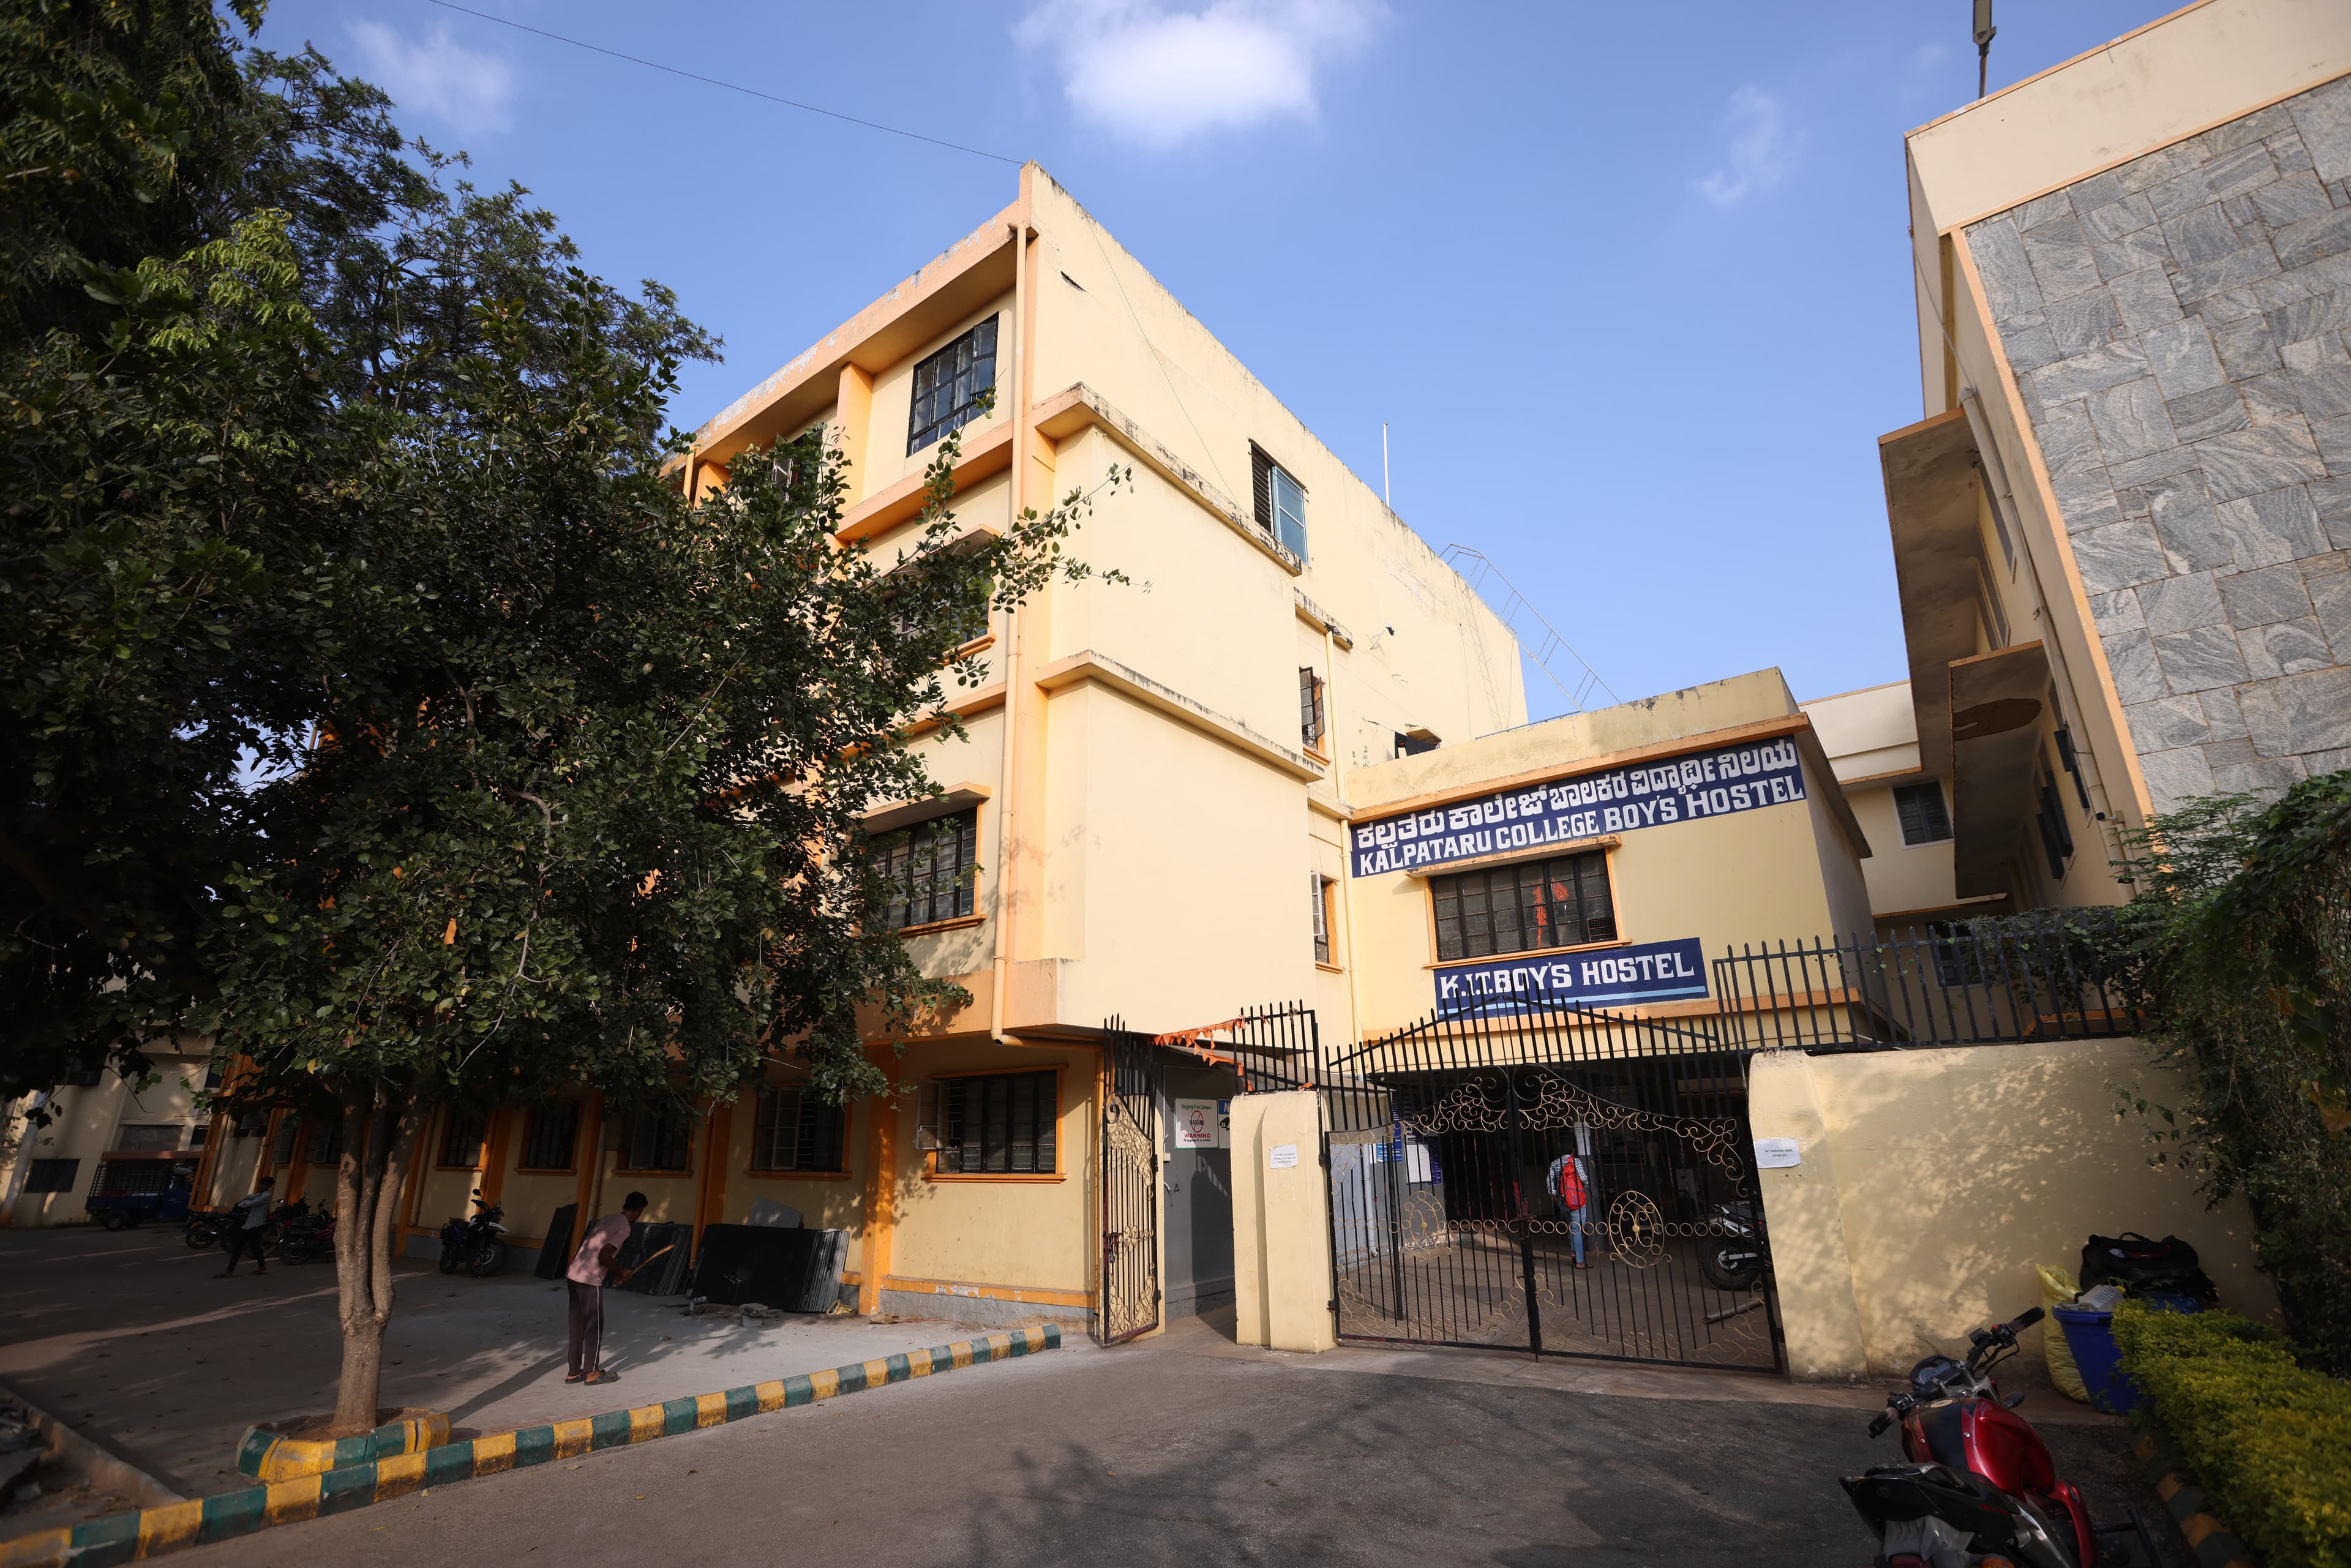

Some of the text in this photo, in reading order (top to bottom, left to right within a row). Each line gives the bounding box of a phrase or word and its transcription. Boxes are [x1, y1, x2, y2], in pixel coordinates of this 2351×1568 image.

[1550, 771, 1629, 811] ಬಾಲಕರ
[1360, 775, 1805, 876] KALPATARU COLLEGE BOY'S HOSTEL
[1581, 952, 1695, 986] HOSTEL
